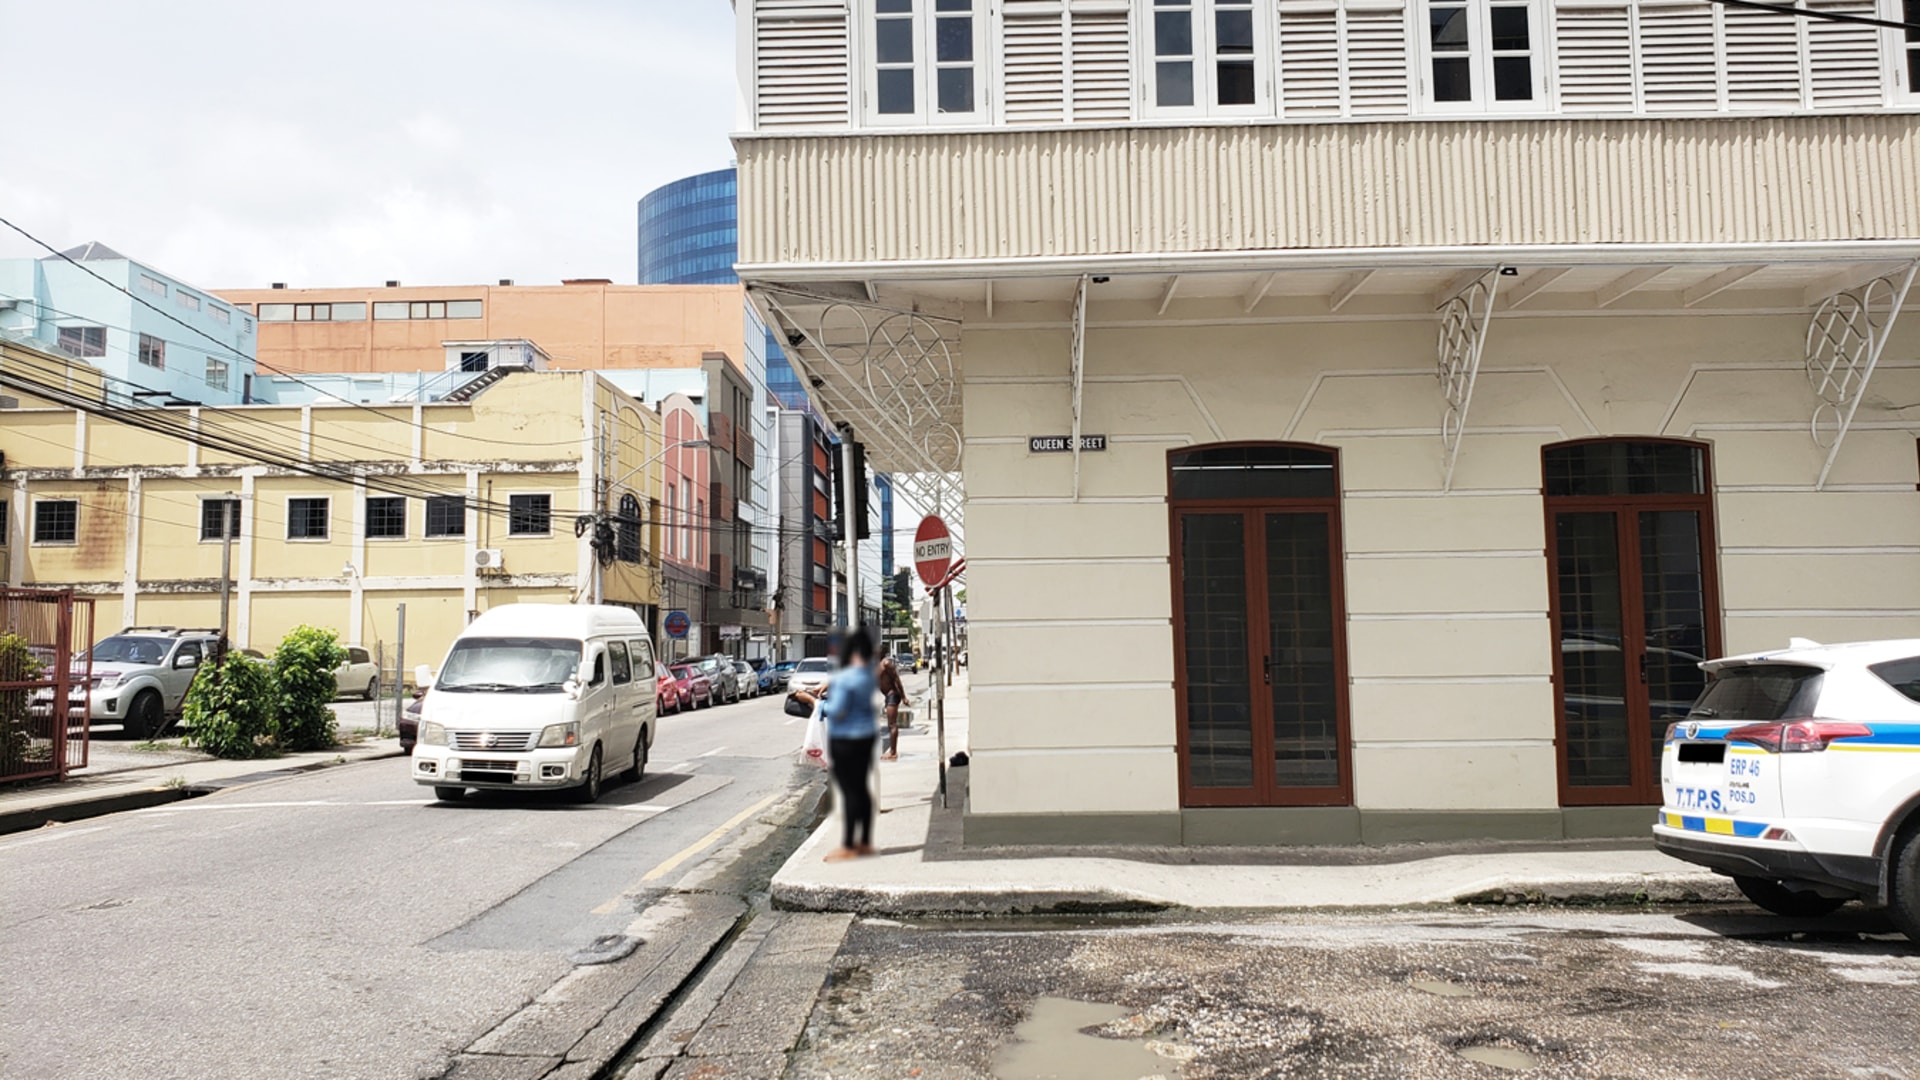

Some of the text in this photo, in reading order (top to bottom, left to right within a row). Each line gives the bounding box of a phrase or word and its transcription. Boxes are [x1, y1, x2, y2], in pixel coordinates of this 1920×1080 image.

[1032, 437, 1103, 450] QUEEN SREET
[916, 542, 950, 557] NO ENTRY
[1730, 758, 1760, 777] ERP 46
